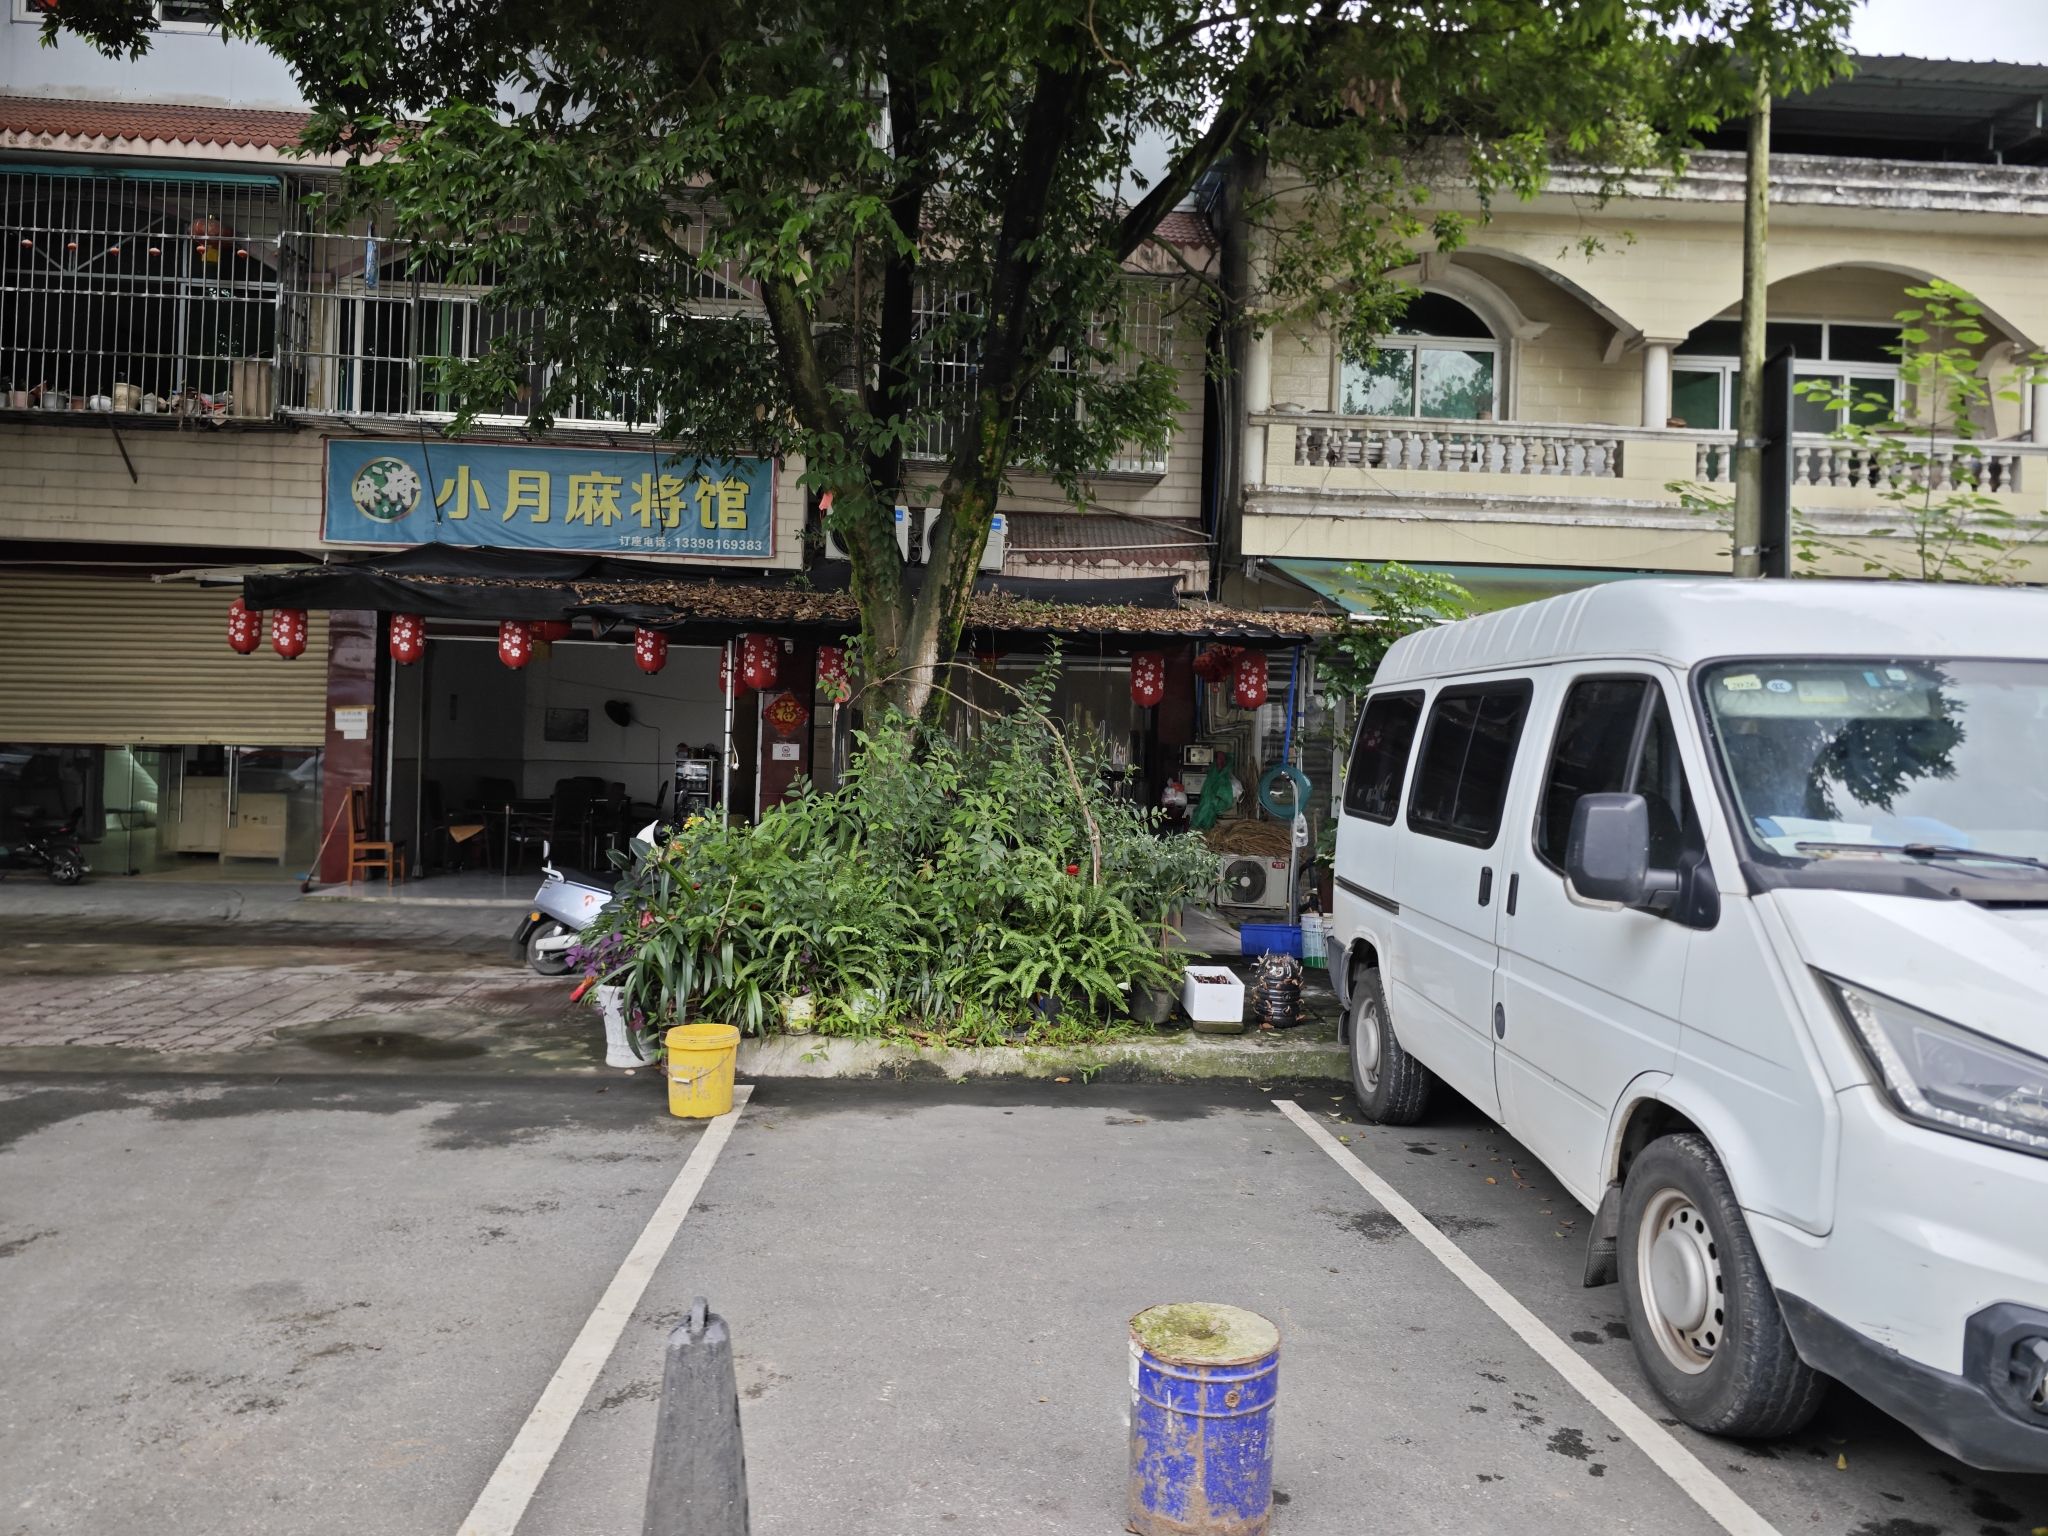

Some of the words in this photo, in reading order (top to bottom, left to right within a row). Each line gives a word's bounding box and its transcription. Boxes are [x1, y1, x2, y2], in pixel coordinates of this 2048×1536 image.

[435, 465, 751, 530] 小月麻将馆
[775, 701, 797, 723] 福
